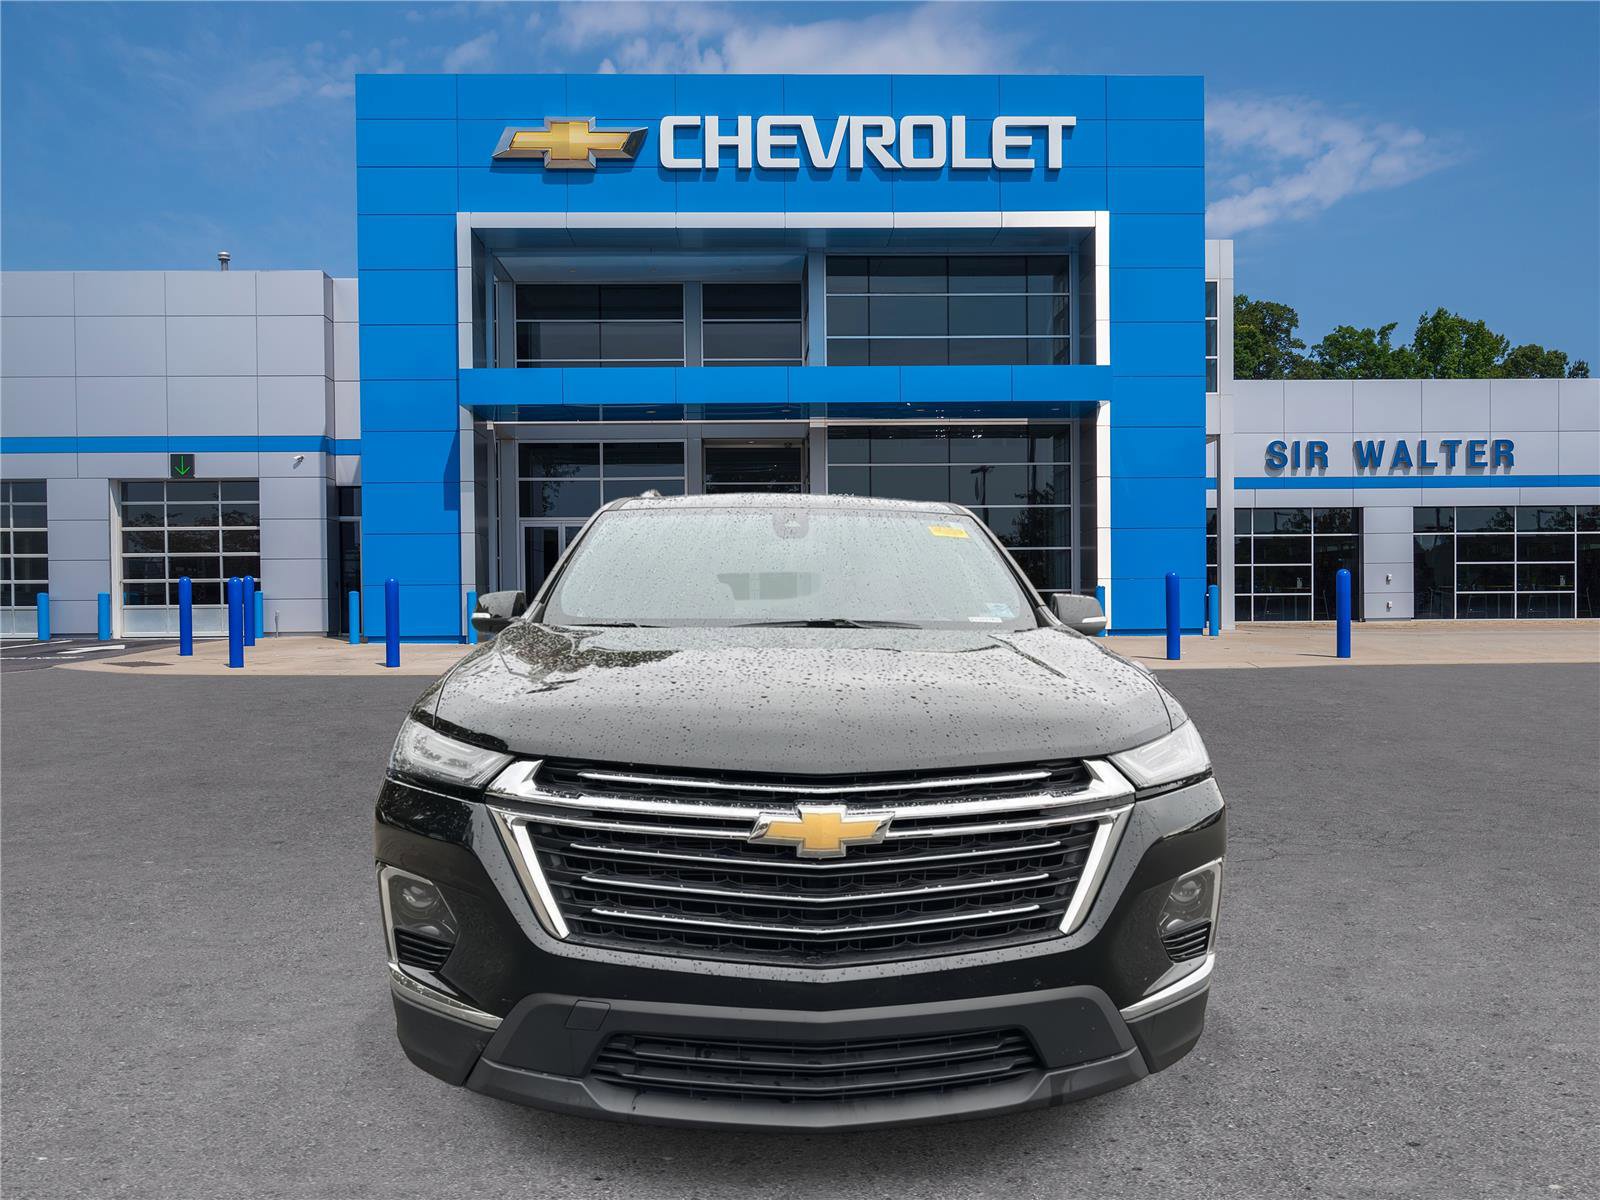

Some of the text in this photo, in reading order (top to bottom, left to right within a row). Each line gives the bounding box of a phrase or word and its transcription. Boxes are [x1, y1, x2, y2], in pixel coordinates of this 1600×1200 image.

[660, 115, 1077, 169] CHEVROLET
[1265, 439, 1515, 469] SIR WALTER
